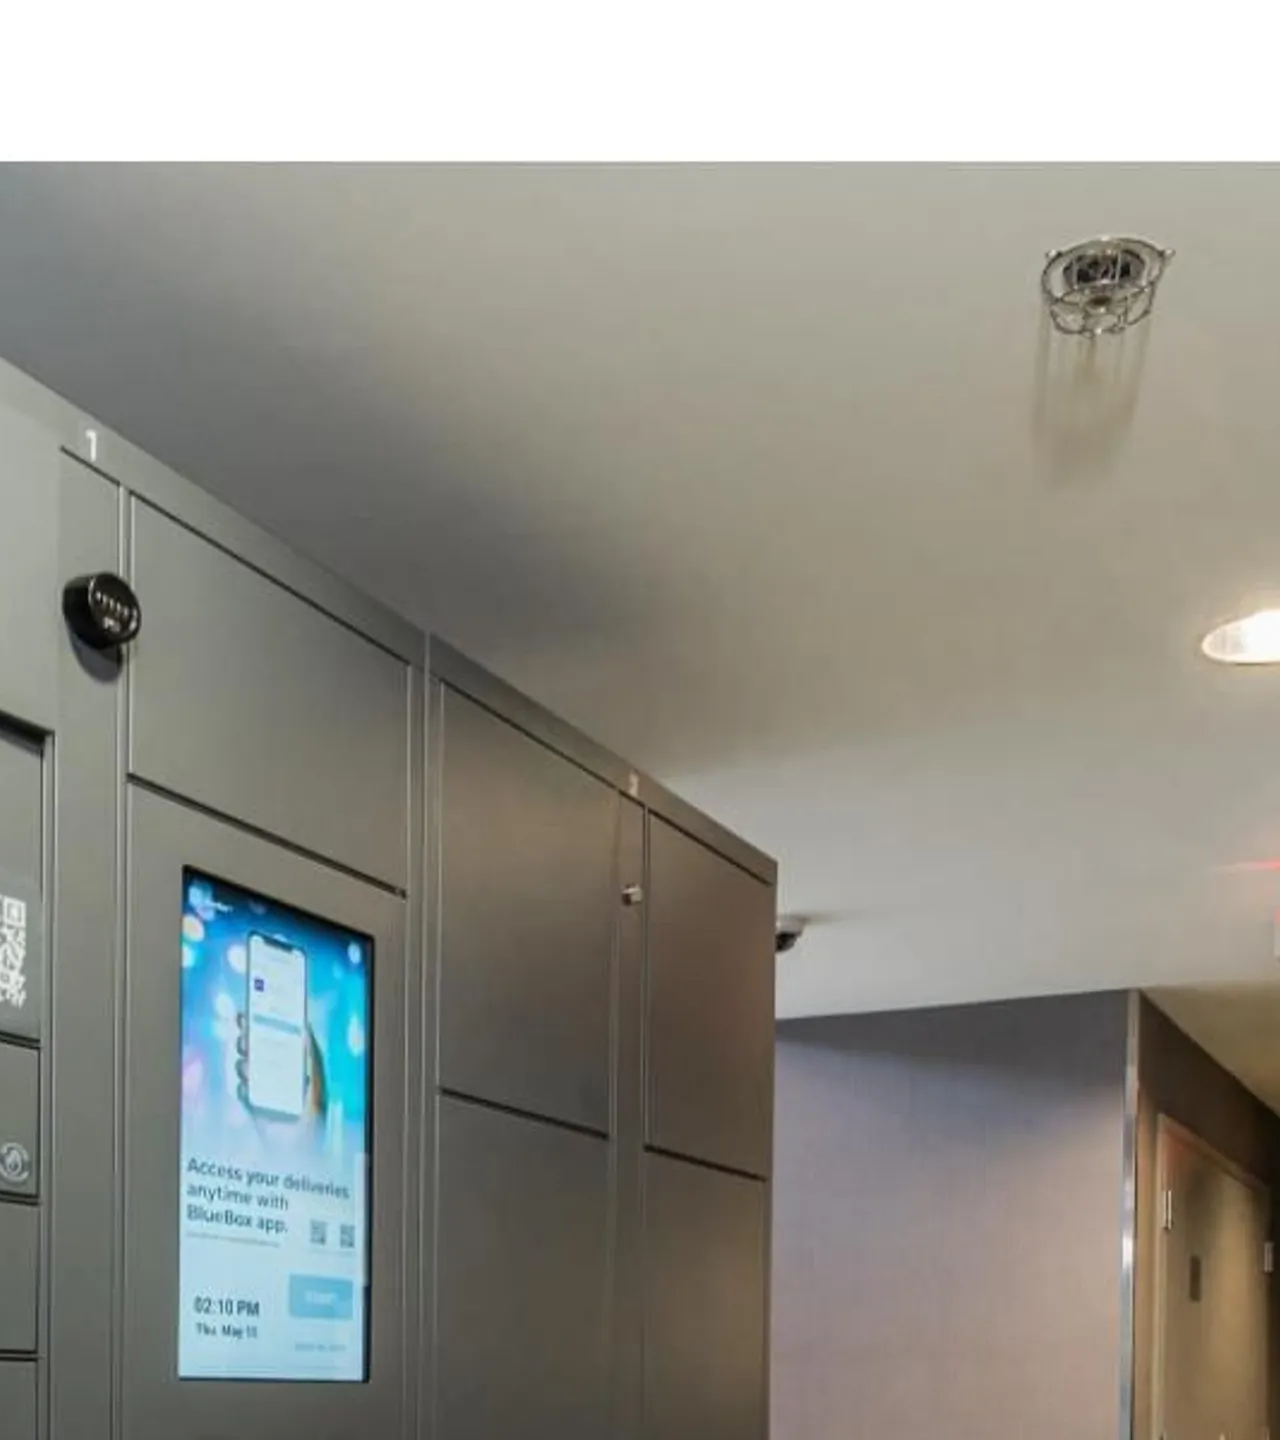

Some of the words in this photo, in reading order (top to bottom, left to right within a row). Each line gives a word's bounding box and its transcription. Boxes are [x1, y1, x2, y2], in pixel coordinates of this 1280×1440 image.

[186, 1157, 242, 1181] Access
[246, 1170, 279, 1188] your
[283, 1173, 350, 1200] deliveries
[186, 1184, 252, 1206] anytime
[257, 1193, 289, 1211] with
[186, 1203, 252, 1229] BlueBox
[256, 1218, 288, 1235] app.
[237, 1299, 260, 1318] PM
